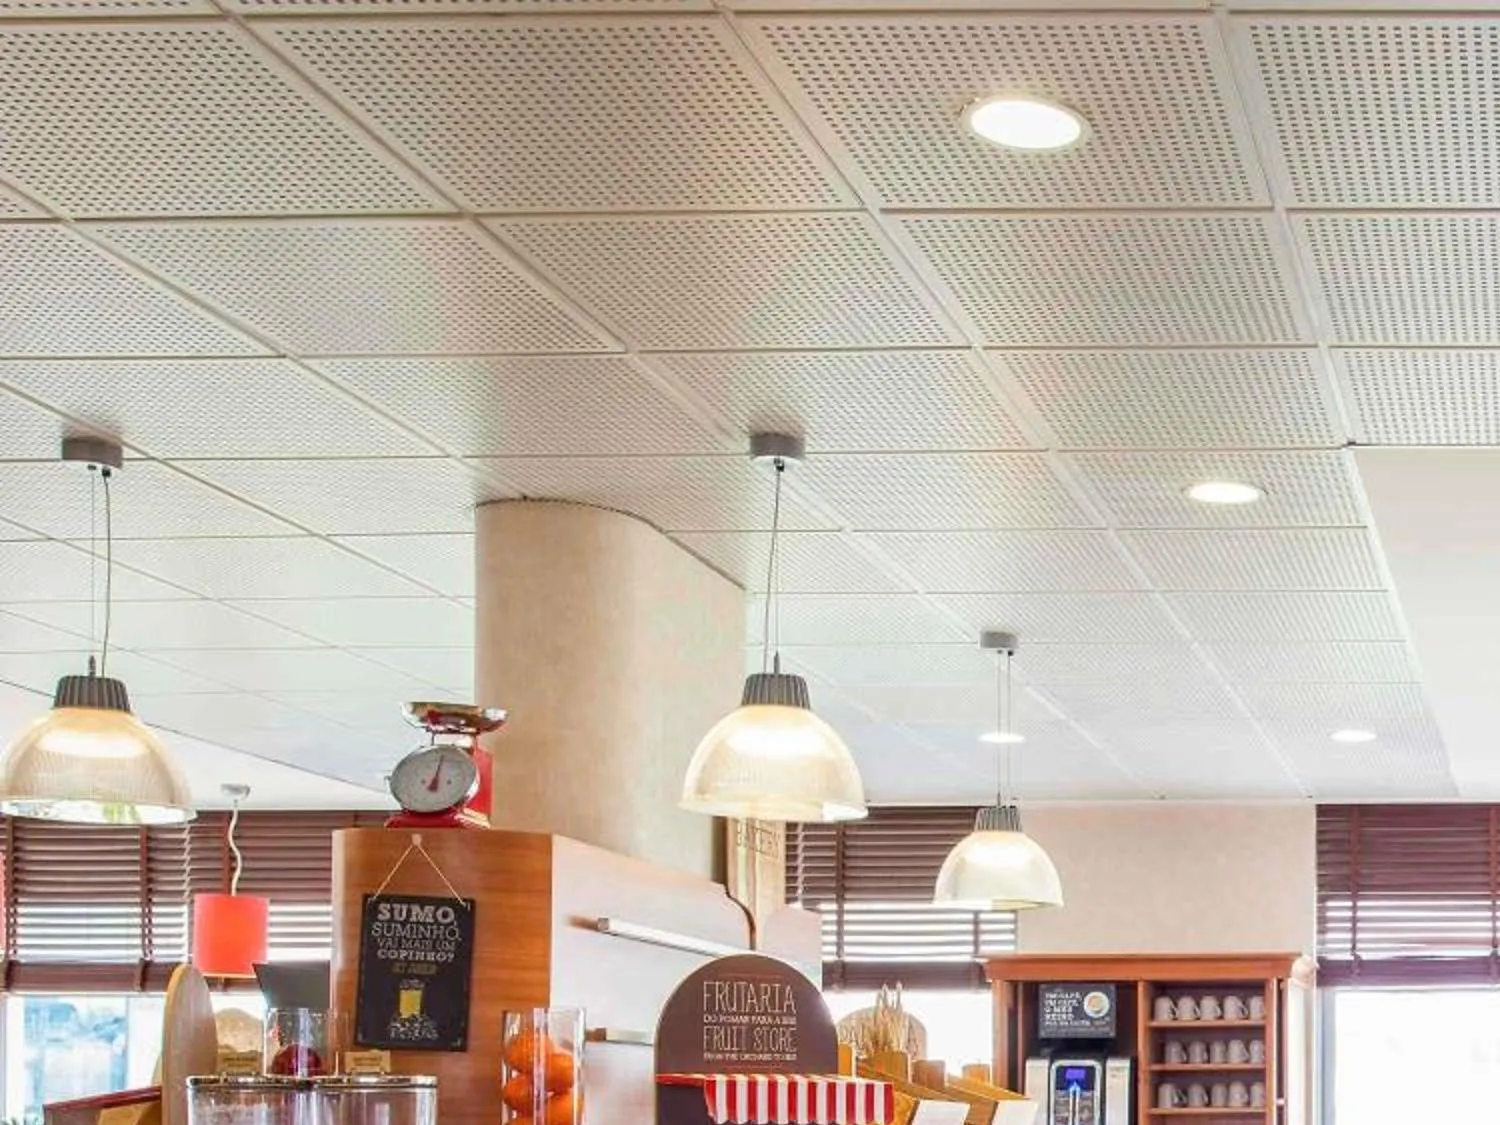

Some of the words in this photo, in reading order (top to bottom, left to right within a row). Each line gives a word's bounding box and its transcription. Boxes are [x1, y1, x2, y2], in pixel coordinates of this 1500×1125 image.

[377, 903, 457, 926] SUMO,
[377, 949, 455, 962] COPINHO?
[704, 981, 797, 1014] FRUTARIA
[704, 1025, 748, 1051] FRUIT
[753, 1027, 797, 1052] STORE
